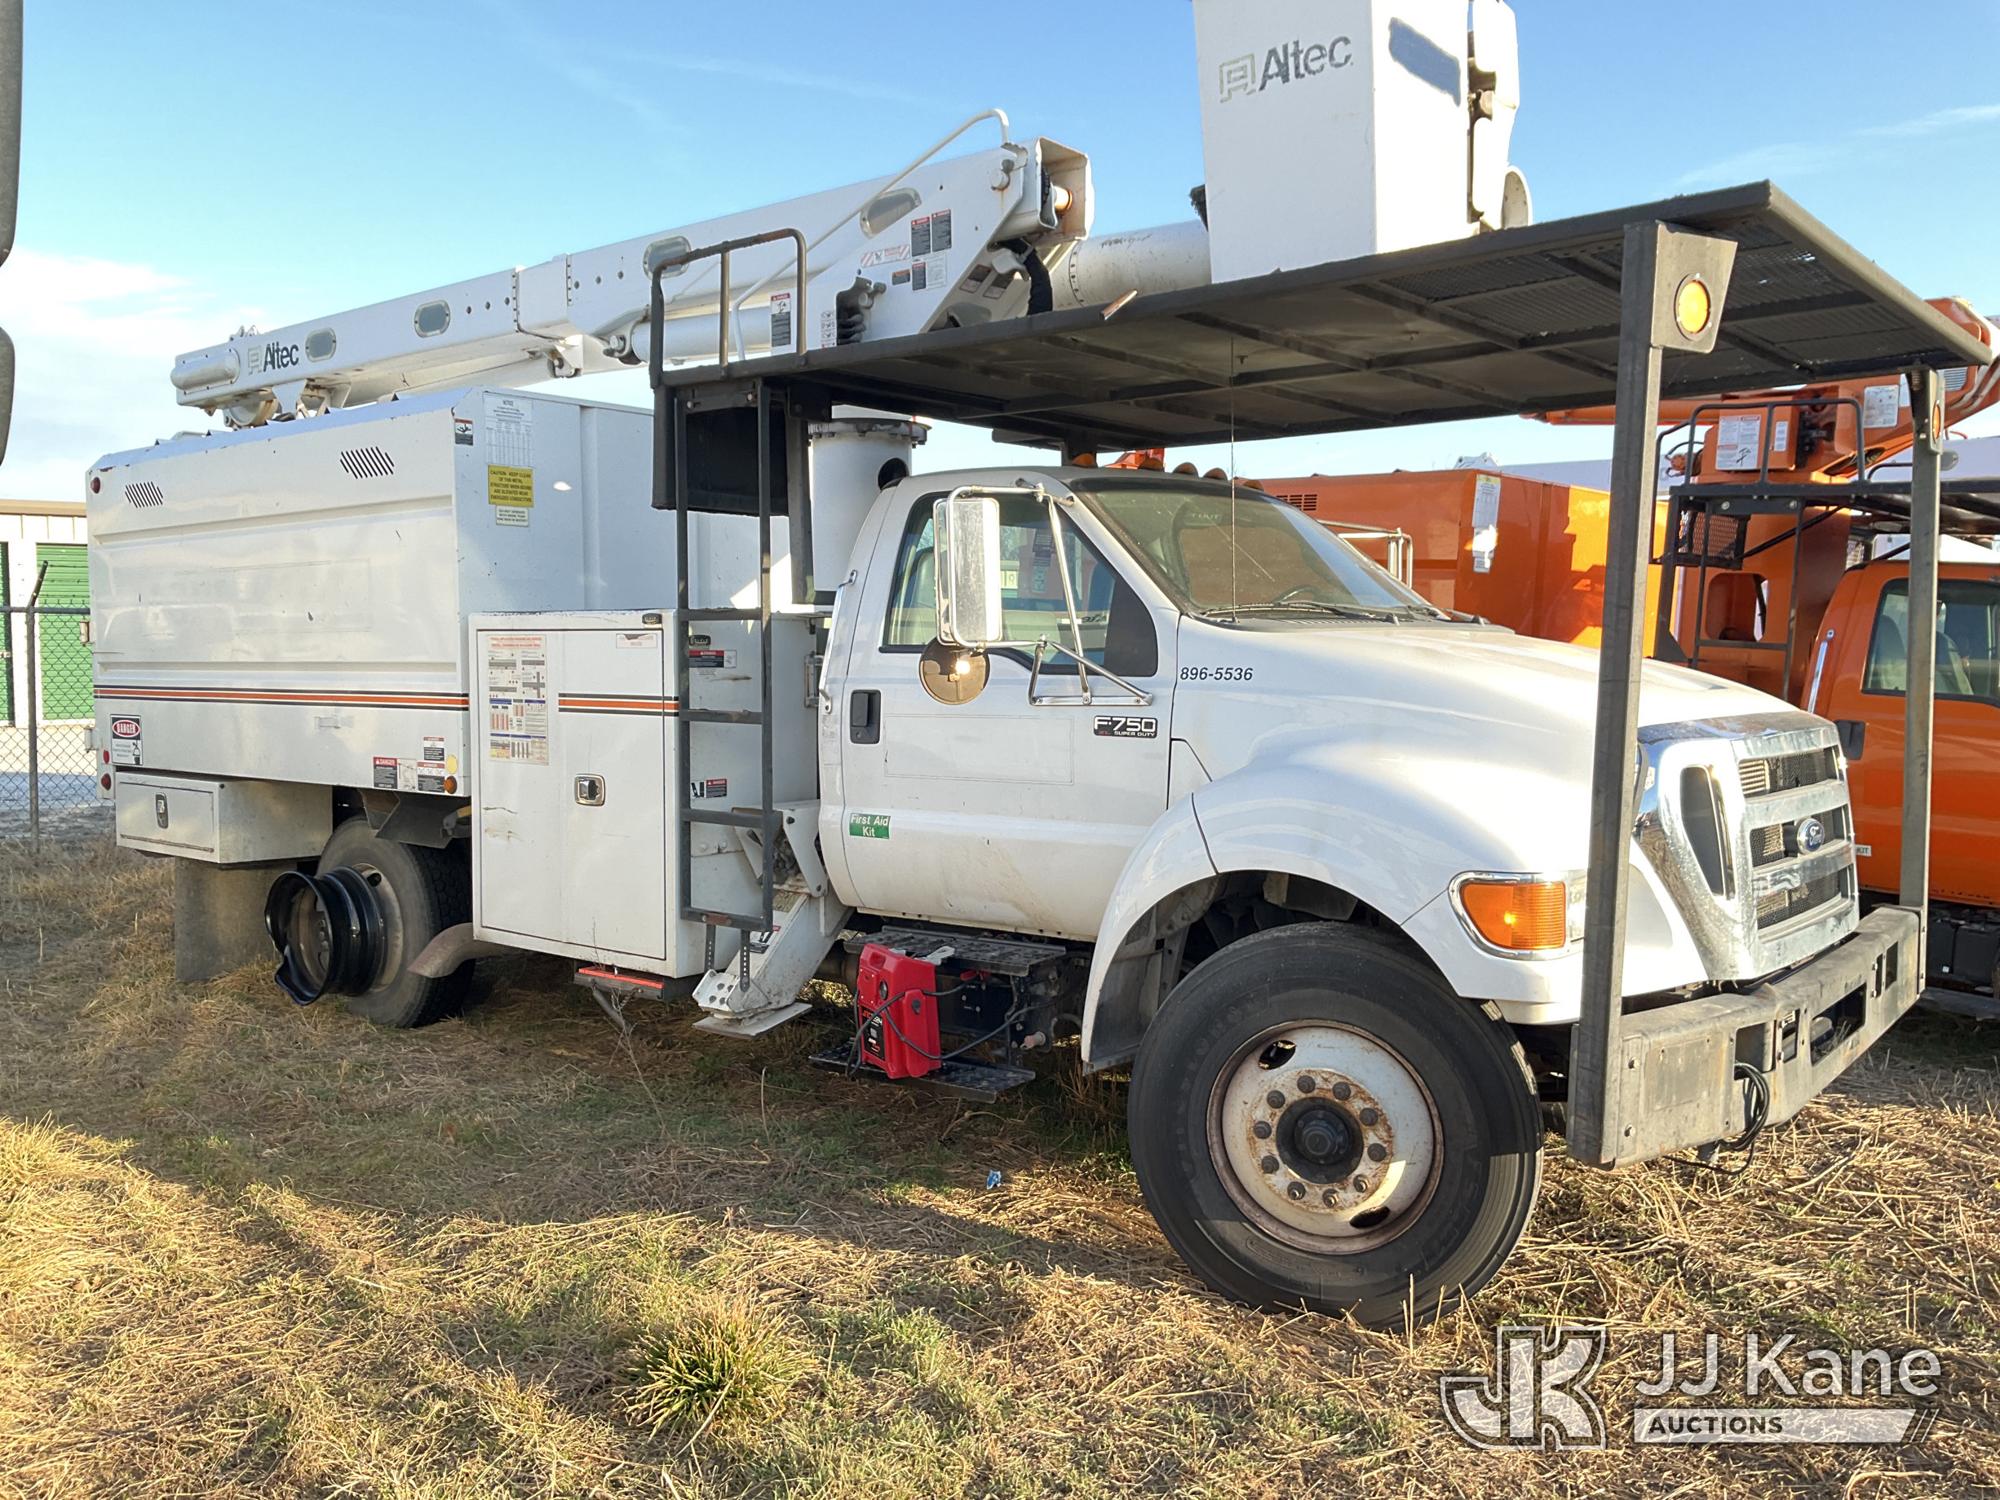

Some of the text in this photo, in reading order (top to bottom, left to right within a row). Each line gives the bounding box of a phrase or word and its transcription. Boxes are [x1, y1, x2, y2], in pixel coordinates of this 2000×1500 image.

[1259, 35, 1353, 91] Altec
[263, 341, 299, 372] Altec
[1180, 667, 1253, 681] 896-5536
[851, 814, 889, 826] First Aid
[863, 826, 875, 837] Kit
